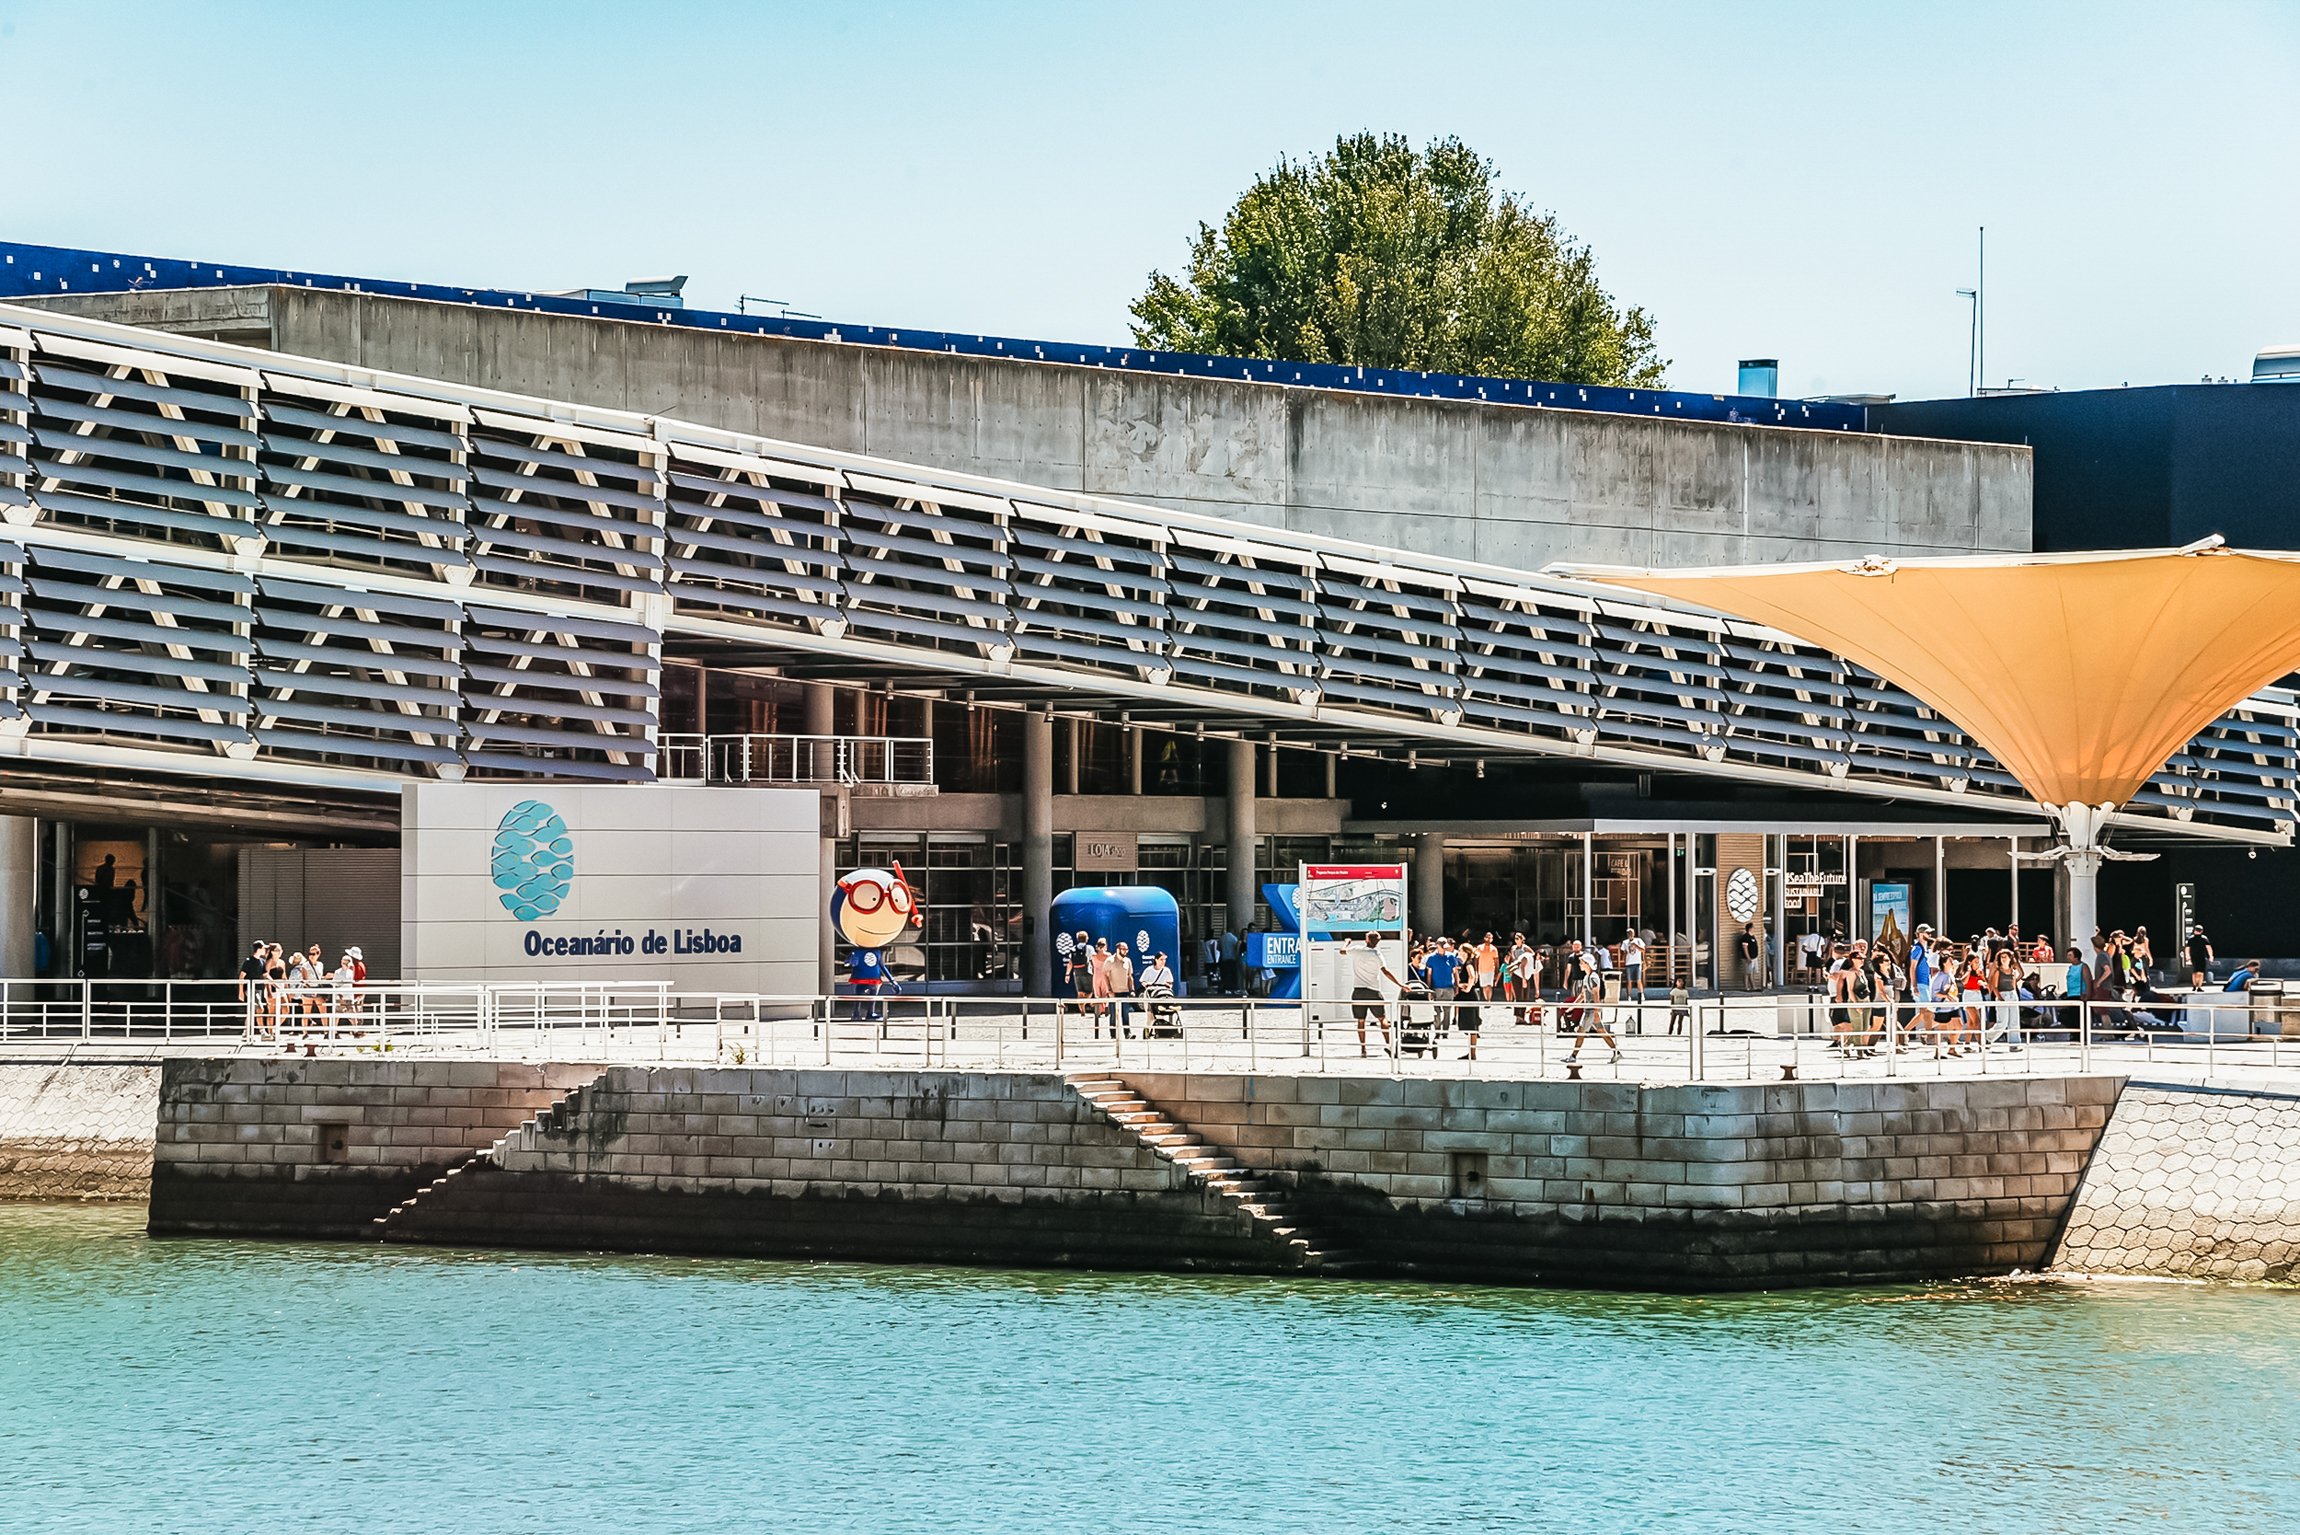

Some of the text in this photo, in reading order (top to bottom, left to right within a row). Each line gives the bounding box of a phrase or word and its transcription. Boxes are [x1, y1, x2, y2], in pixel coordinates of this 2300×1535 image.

[1090, 843, 1110, 858] LOJA
[524, 928, 742, 957] Oceanário de Lisboa
[1267, 954, 1296, 965] ENTRANCE
